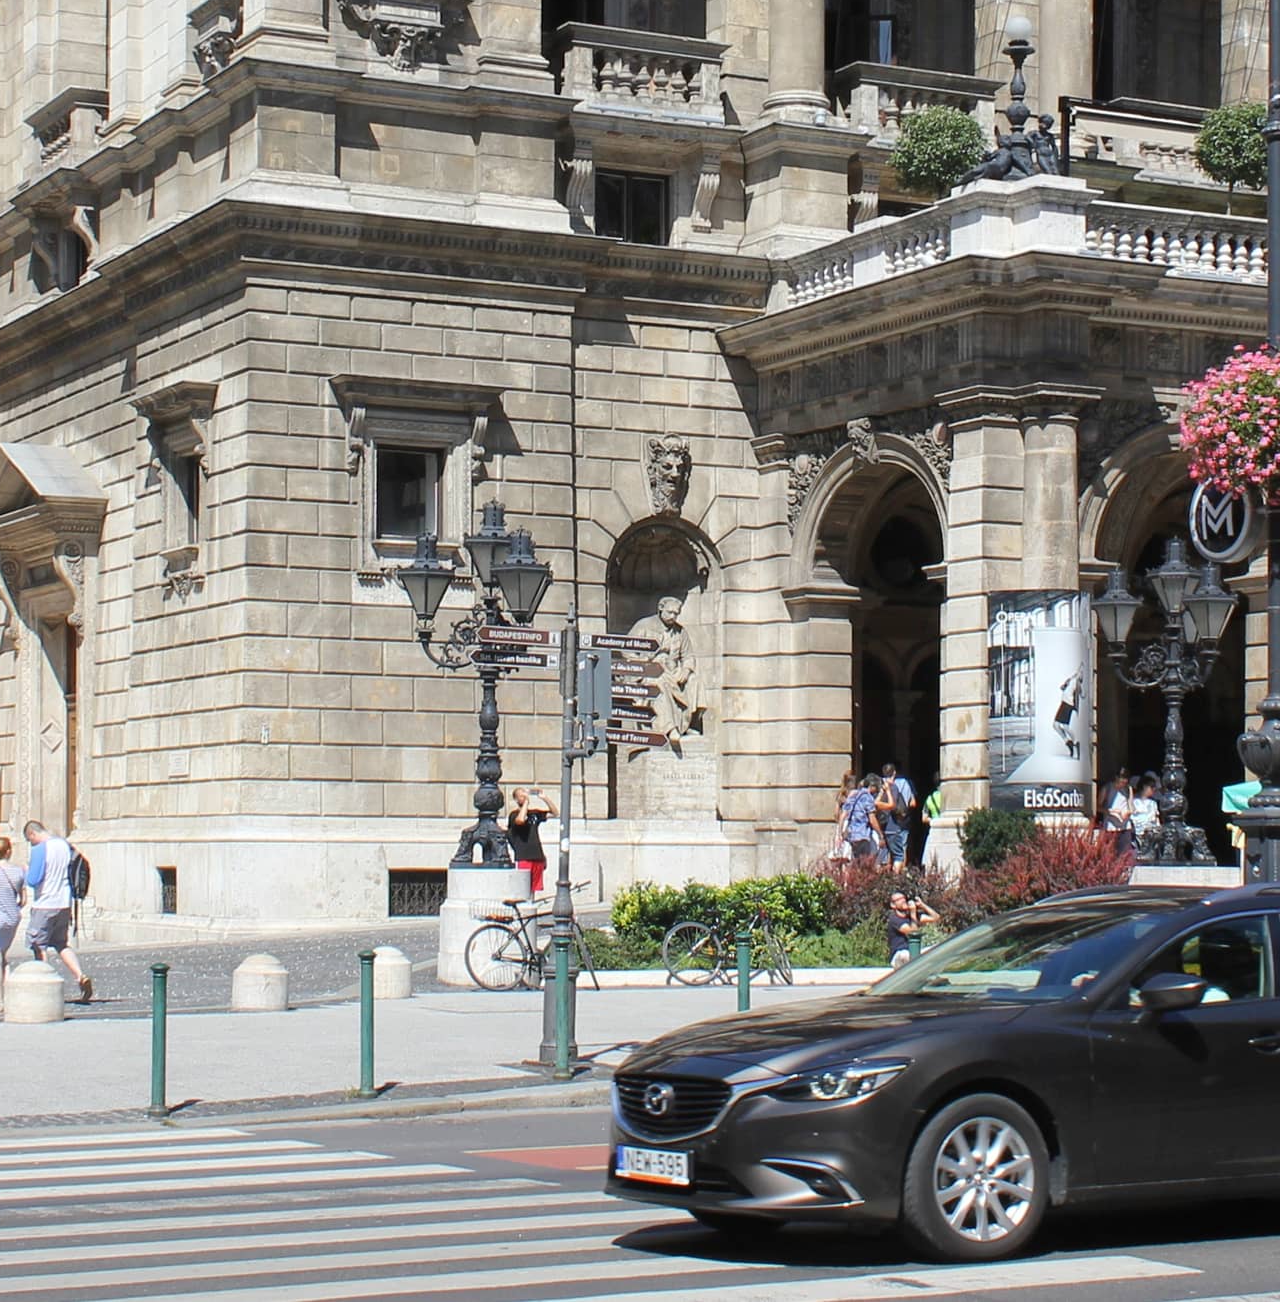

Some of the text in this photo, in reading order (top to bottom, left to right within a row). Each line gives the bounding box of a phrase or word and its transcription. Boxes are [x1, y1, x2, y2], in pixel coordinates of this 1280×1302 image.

[1202, 491, 1234, 540] M
[489, 630, 542, 642] BUDAPESTINFO
[597, 637, 652, 649] Academy of Music
[625, 686, 649, 696] Theatre
[623, 732, 629, 742] of
[630, 733, 649, 744] Terror
